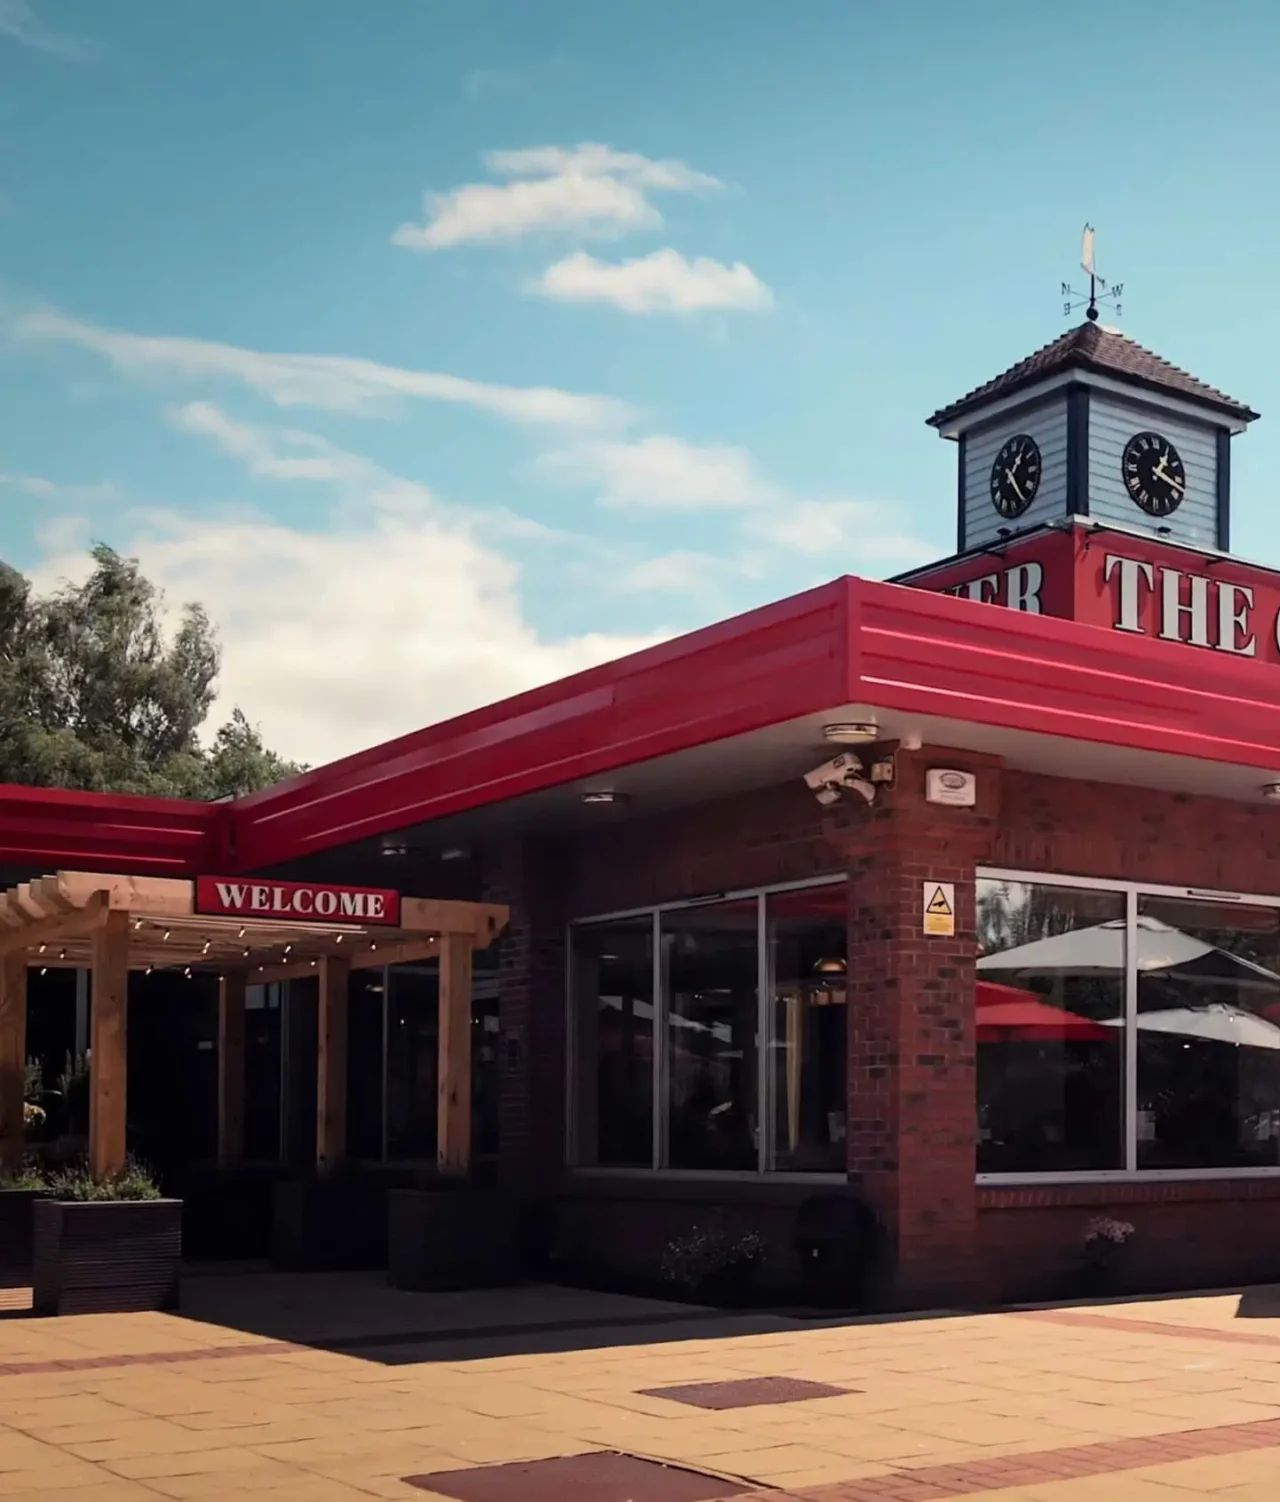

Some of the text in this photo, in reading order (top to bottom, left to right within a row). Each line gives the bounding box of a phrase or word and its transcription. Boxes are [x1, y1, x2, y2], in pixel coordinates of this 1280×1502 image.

[1111, 283, 1124, 298] W
[1104, 553, 1256, 656] THE
[215, 882, 385, 918] WELCOME
